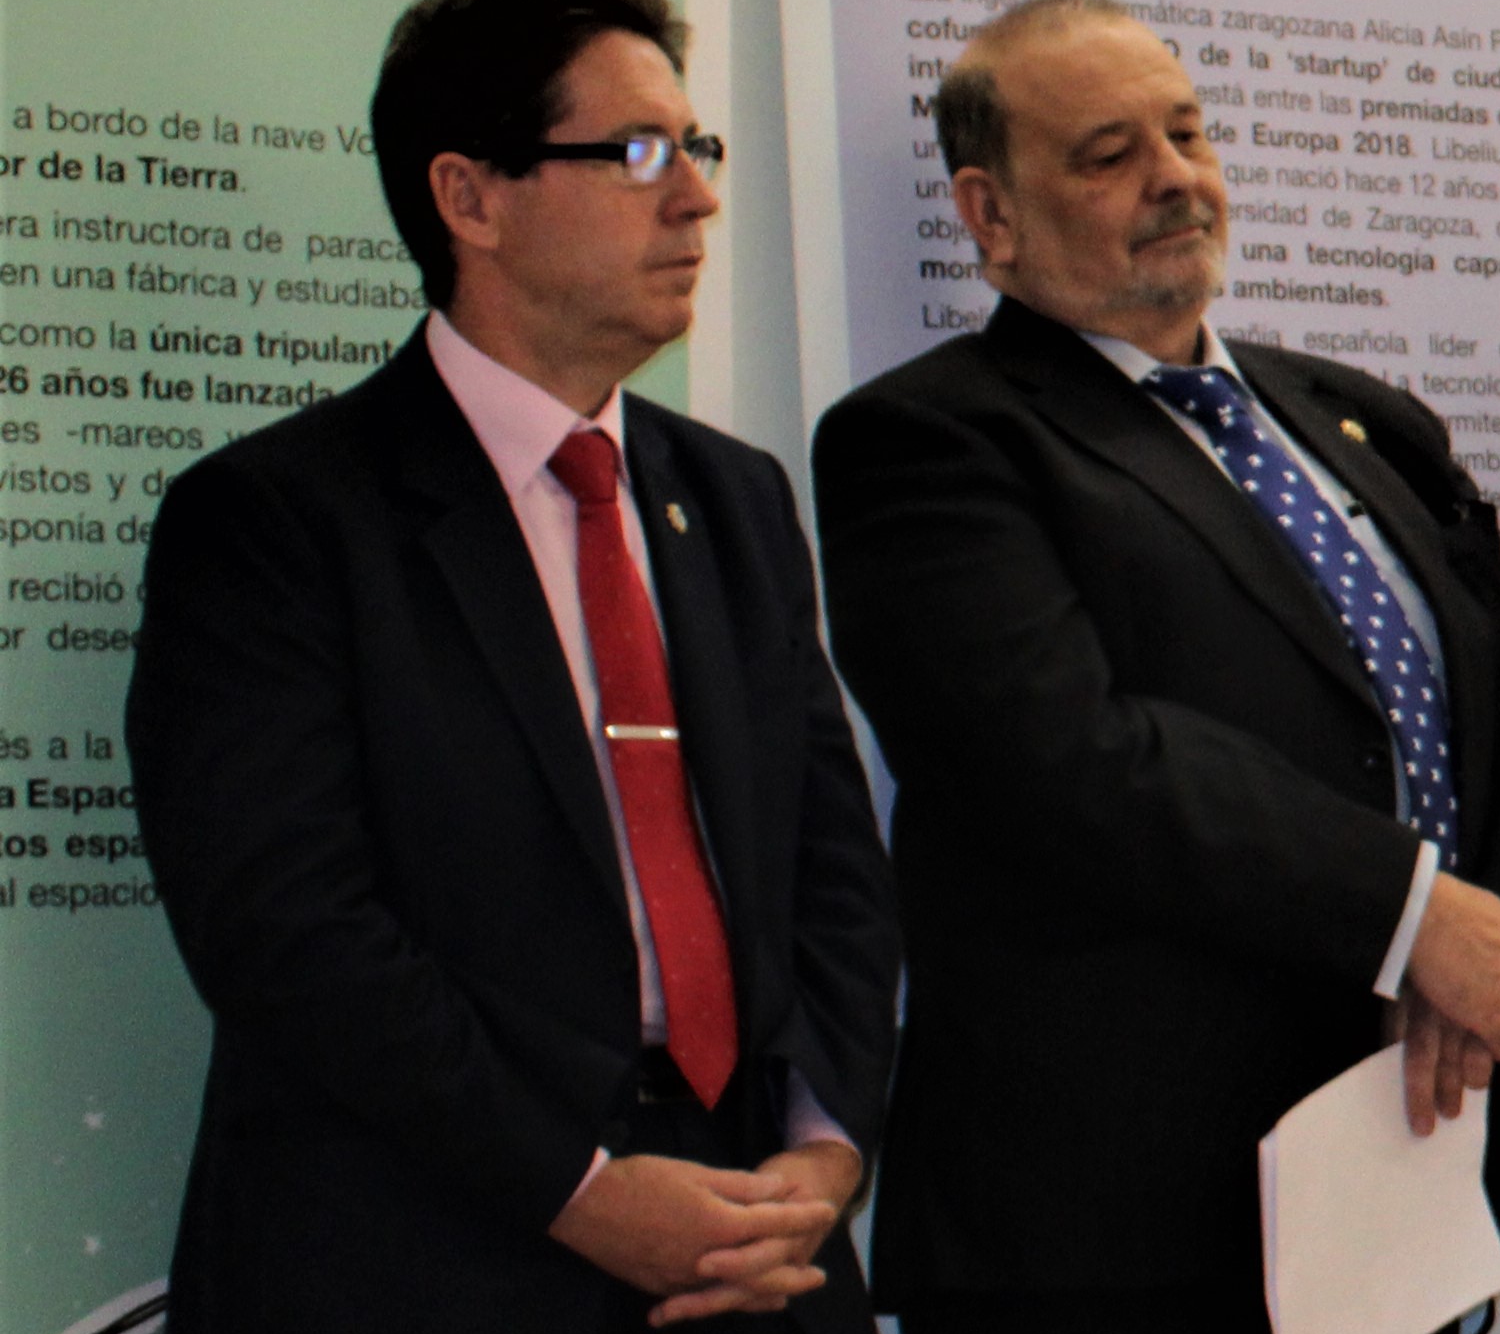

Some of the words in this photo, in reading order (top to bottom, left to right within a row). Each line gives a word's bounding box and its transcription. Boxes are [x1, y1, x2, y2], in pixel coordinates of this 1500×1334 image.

[1199, 43, 1231, 67] de
[1248, 47, 1270, 70] la
[1406, 61, 1436, 84] de
[47, 103, 148, 137] bordo
[160, 112, 201, 142] de
[214, 116, 239, 145] la
[252, 125, 325, 152] nave
[1361, 99, 1489, 125] premiadas
[1252, 122, 1340, 153] Europa
[1353, 132, 1417, 156] 2018.
[38, 151, 82, 181] de
[96, 154, 125, 183] la
[139, 157, 246, 193] Tierra.
[54, 211, 231, 250] instructora
[243, 224, 283, 254] de
[1242, 244, 1288, 263] una
[1305, 242, 1436, 276] tecnología
[53, 267, 115, 291] una
[126, 262, 237, 298] fábrica
[248, 279, 264, 306] y
[1233, 278, 1388, 307] ambientales.
[150, 324, 242, 356] única
[41, 367, 129, 399] años
[141, 371, 193, 402] fue
